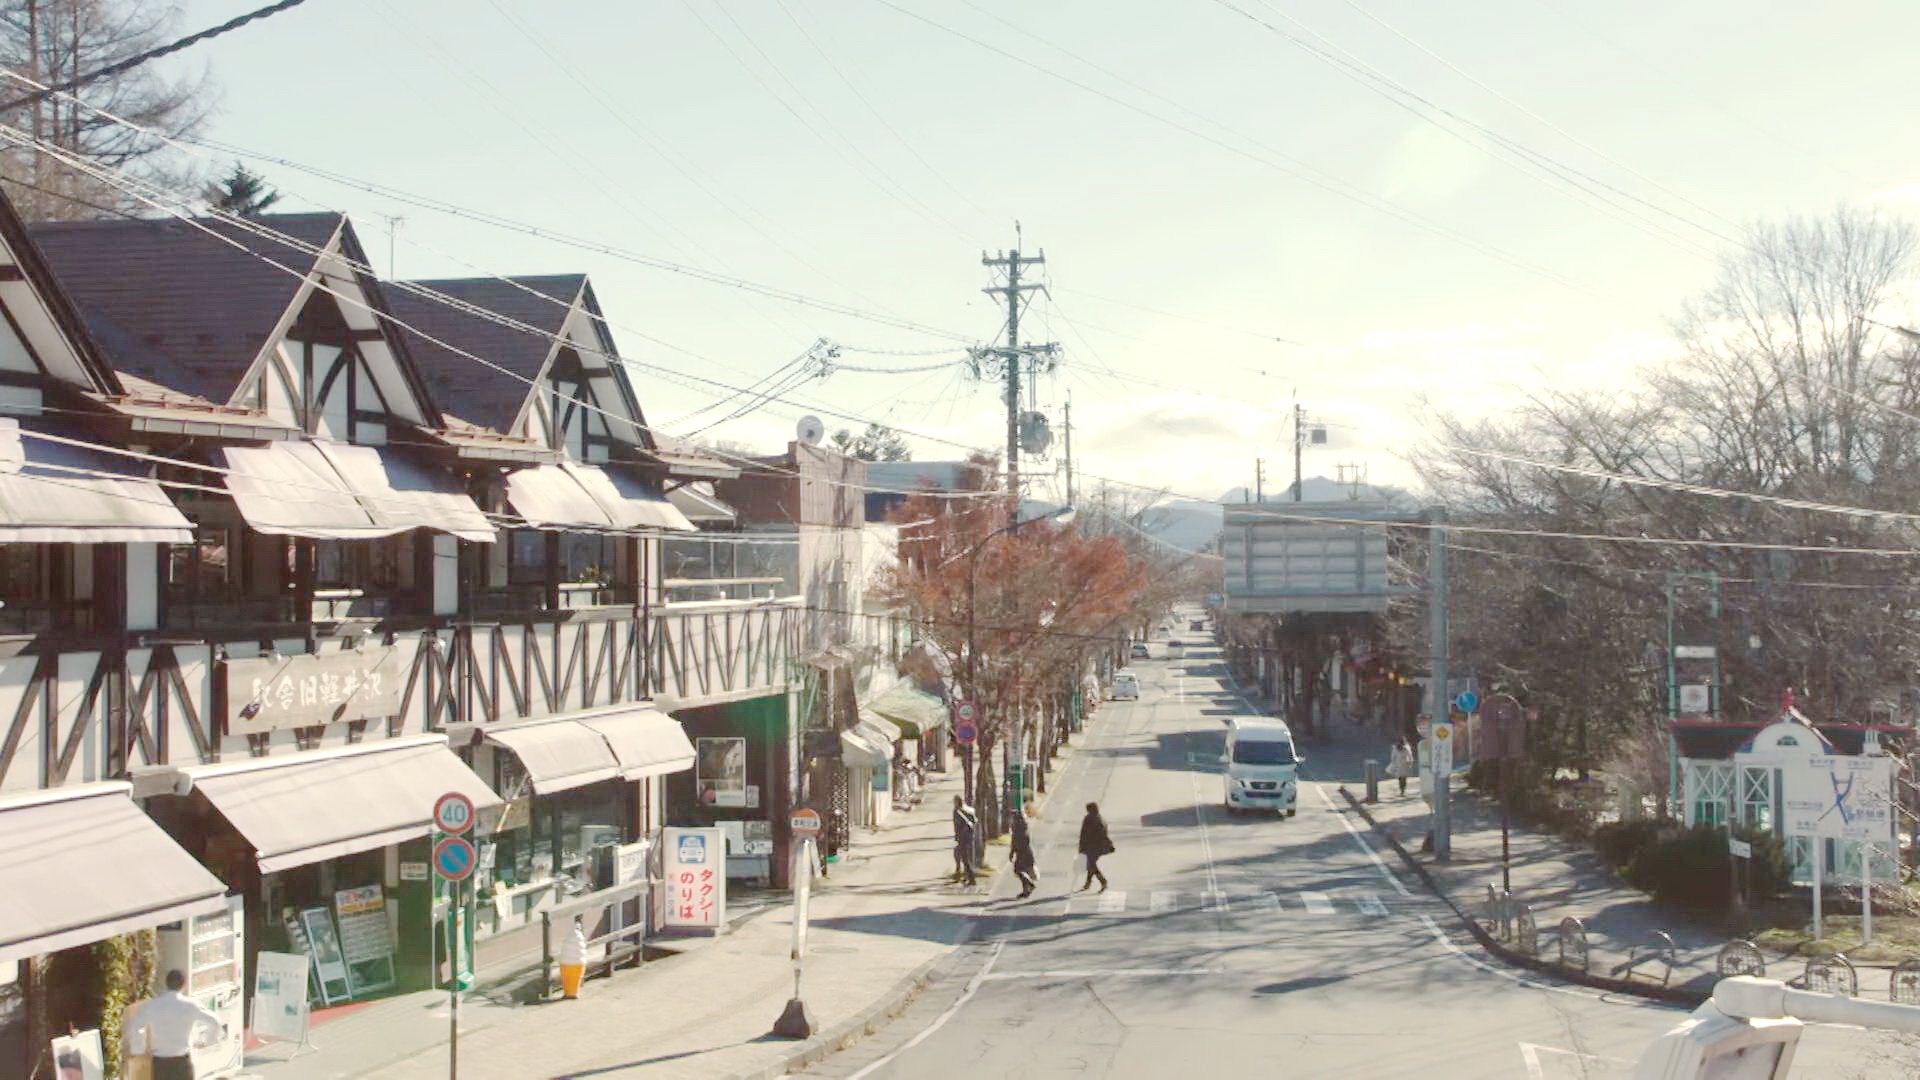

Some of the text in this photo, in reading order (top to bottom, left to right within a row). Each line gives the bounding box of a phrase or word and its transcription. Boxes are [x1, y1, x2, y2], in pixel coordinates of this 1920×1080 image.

[443, 804, 466, 822] 40
[679, 871, 695, 920] のりば
[699, 868, 713, 922] タクシー
